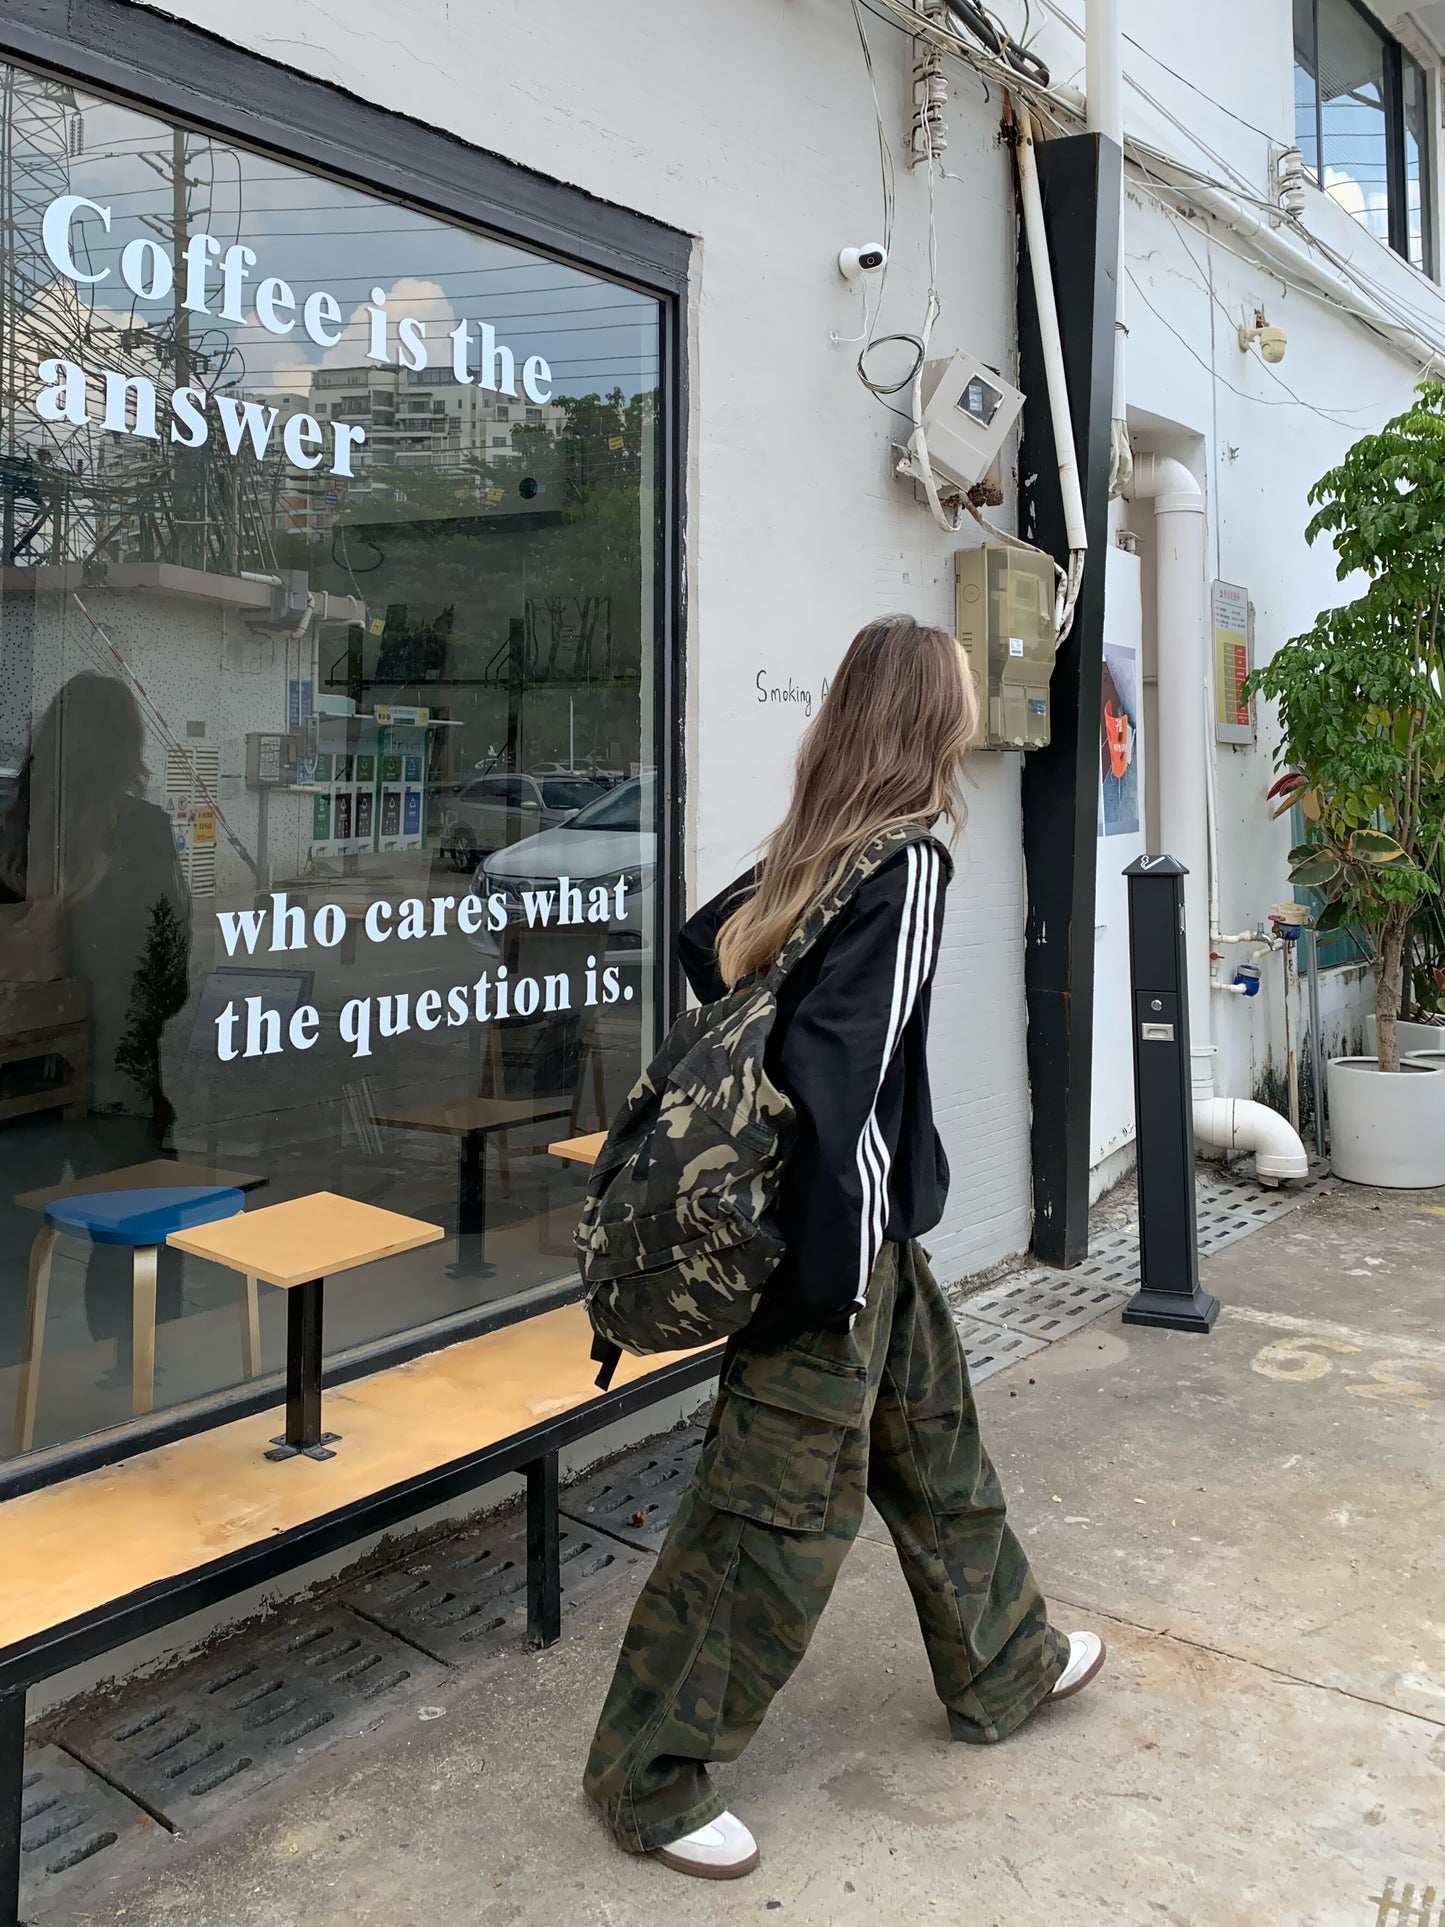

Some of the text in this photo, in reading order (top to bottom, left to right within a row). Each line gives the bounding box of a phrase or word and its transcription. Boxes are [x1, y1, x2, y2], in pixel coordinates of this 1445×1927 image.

[42, 195, 554, 405] Coffee is the
[35, 358, 367, 479] answer
[756, 669, 811, 717] Smoking
[216, 873, 630, 957] who cares what
[214, 954, 635, 1062] the question is.
